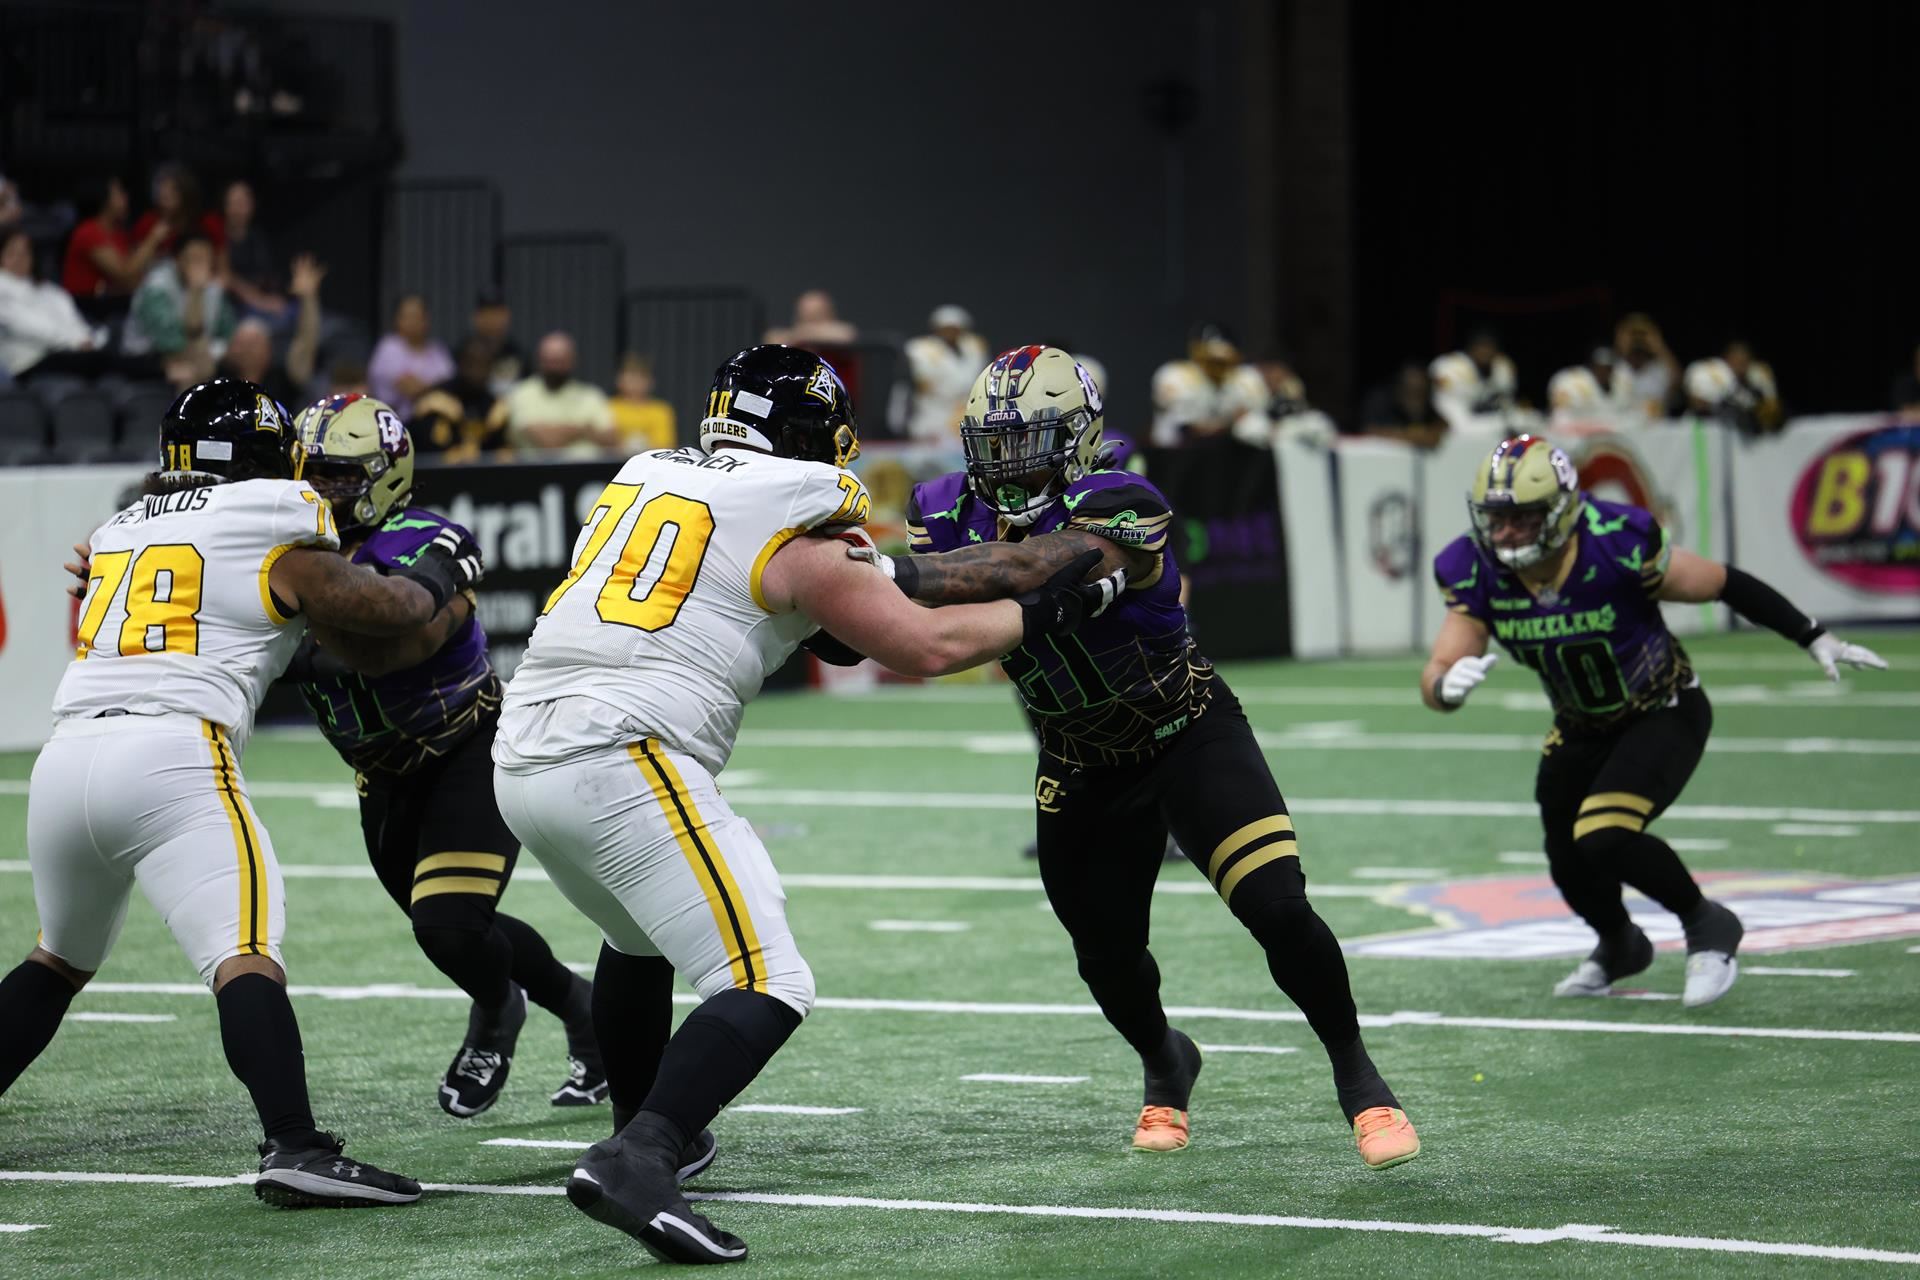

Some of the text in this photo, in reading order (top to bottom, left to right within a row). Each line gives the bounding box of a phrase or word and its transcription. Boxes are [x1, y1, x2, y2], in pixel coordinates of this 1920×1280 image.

[986, 411, 1017, 422] SQUAD
[712, 421, 748, 439] OILERS
[1121, 529, 1146, 539] CITY
[541, 481, 717, 633] 70
[75, 543, 205, 662] 78
